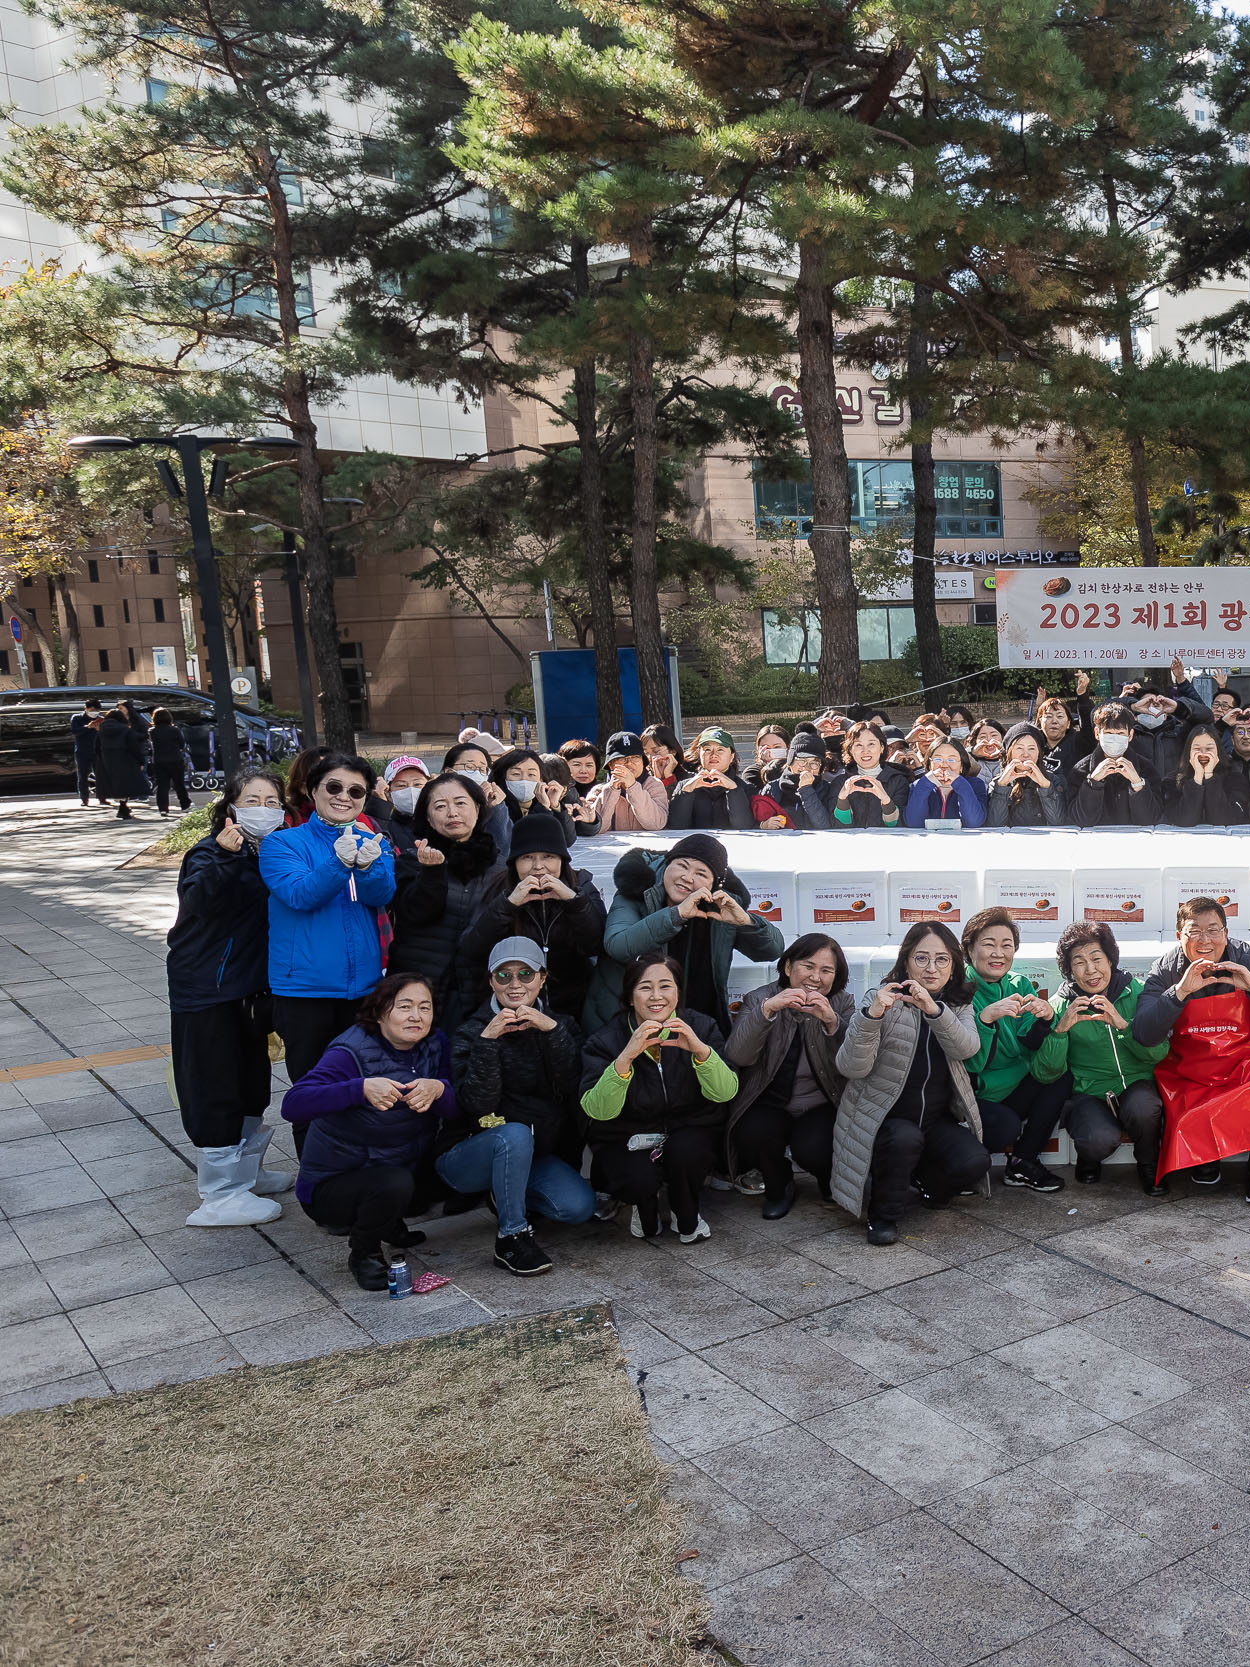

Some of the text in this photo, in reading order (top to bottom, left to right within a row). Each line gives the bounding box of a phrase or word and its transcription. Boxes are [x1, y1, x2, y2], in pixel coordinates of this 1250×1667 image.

[938, 476, 984, 488] 창업 문의
[965, 489, 995, 500] 4650
[933, 549, 1057, 568] 승철헤어스투디오
[1077, 583, 1205, 594] 김치 한상자로 전하는 안부
[1039, 603, 1121, 629] 2023
[1130, 600, 1207, 631] 제1회
[1054, 650, 1080, 659] 2023.
[1083, 650, 1097, 659] 11.
[1099, 649, 1128, 660] 20(월)
[1168, 648, 1225, 660] 나루아트센터
[1227, 648, 1247, 660] 광장
[236, 679, 247, 695] P
